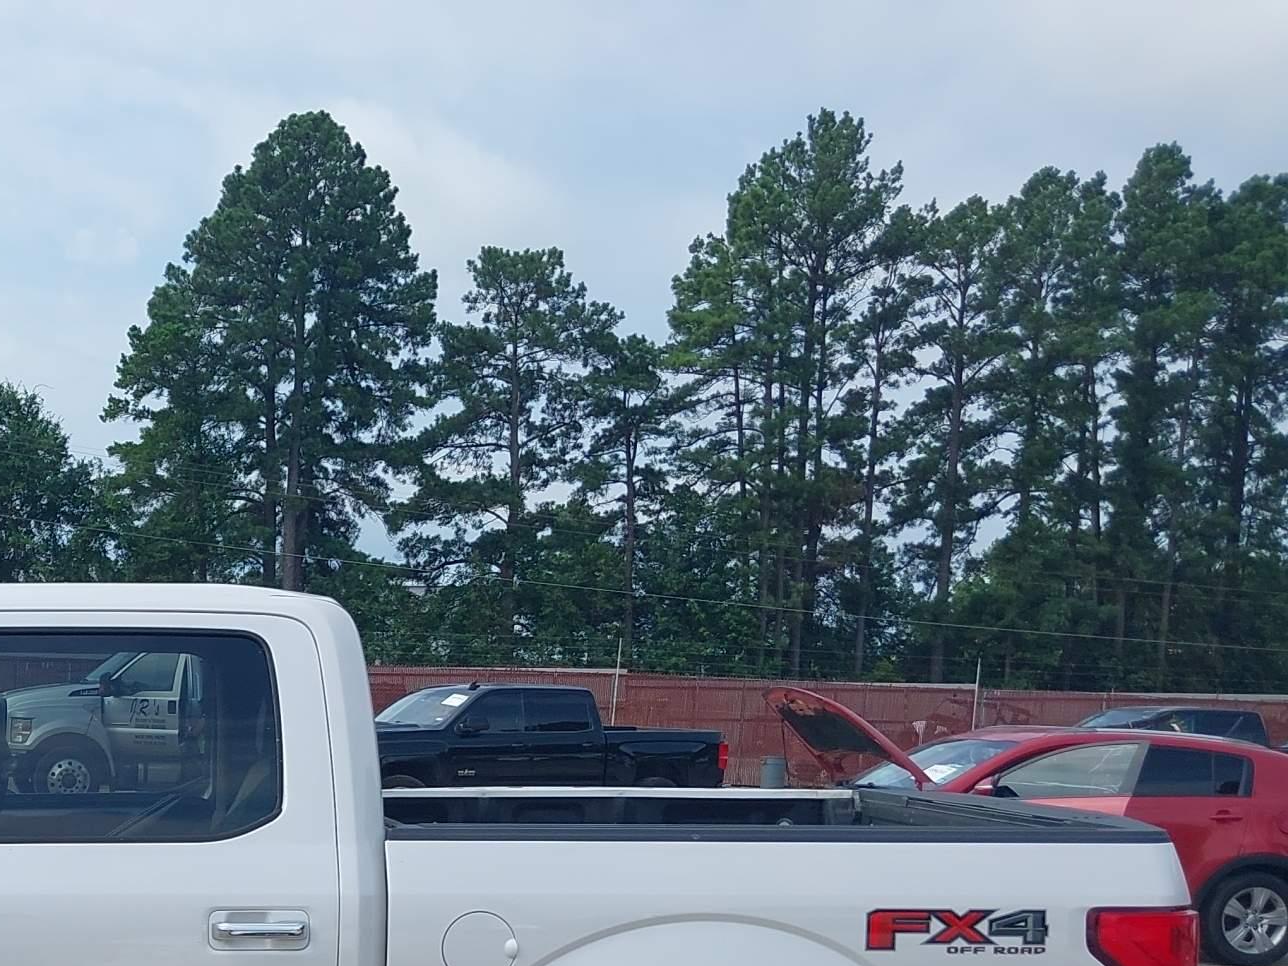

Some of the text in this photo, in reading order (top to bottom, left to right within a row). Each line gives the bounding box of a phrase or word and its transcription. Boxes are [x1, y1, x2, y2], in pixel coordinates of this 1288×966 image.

[865, 908, 1049, 951] FX4
[946, 946, 1047, 955] OFF ROAD
